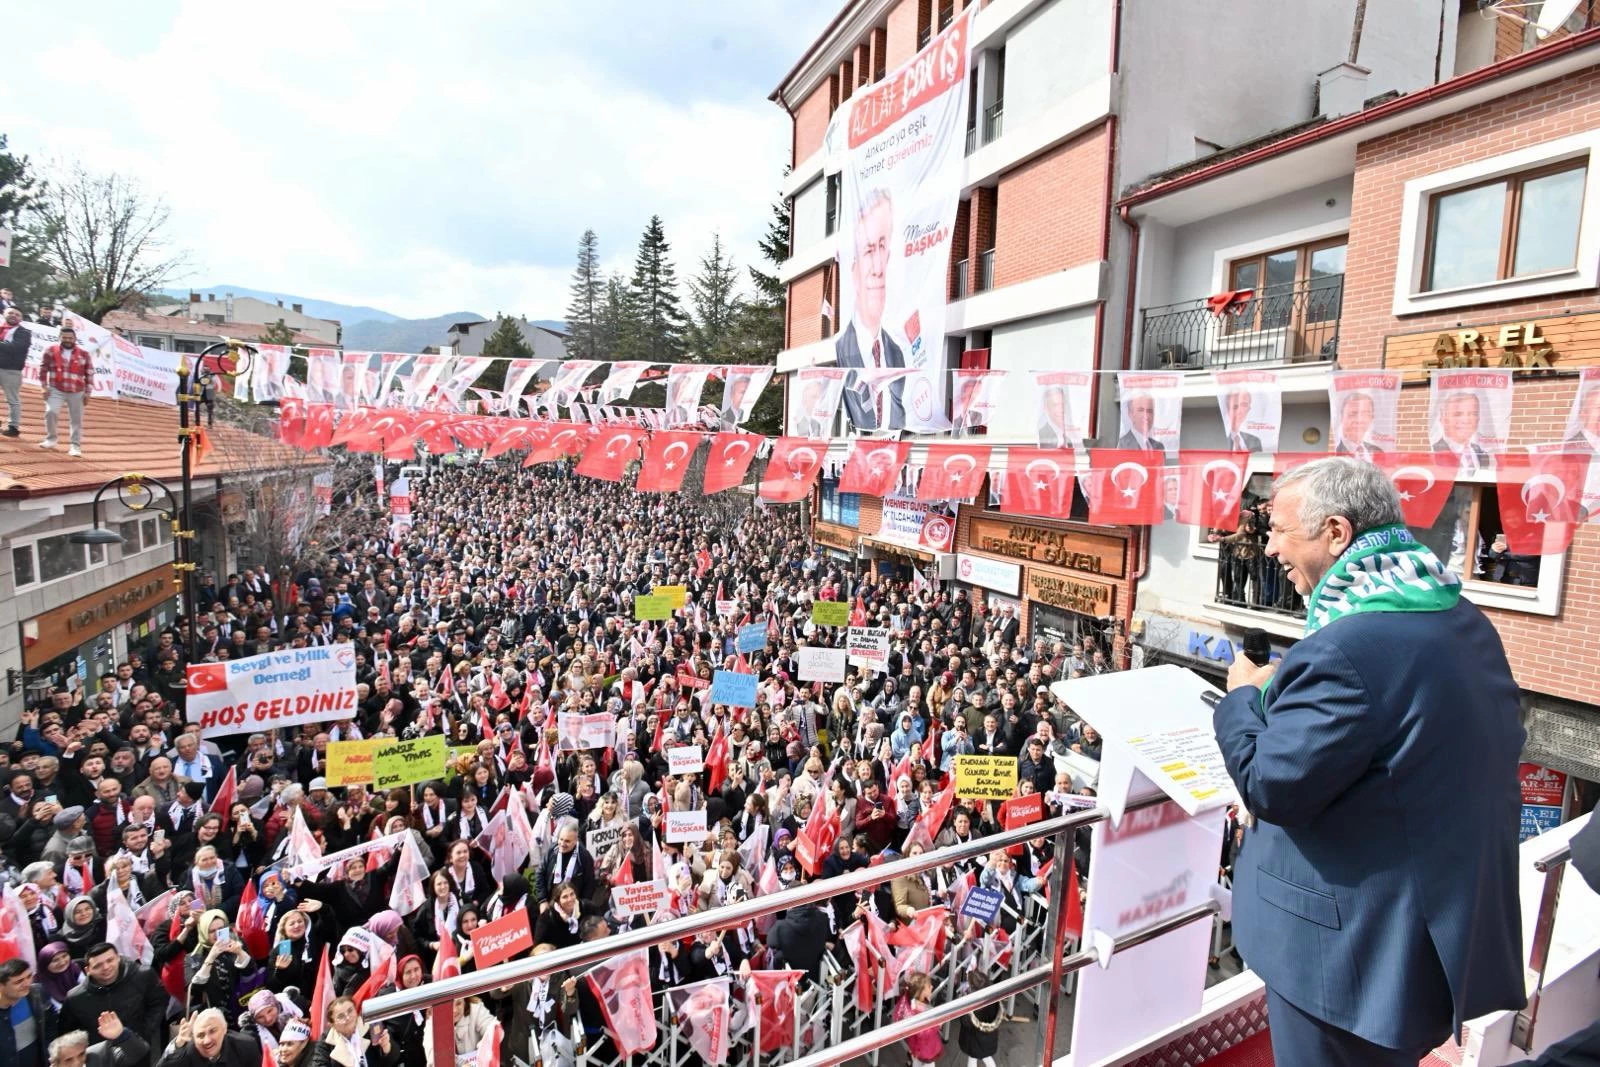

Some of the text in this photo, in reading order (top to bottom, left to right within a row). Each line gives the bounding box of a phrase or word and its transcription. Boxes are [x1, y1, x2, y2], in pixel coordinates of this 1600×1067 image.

[852, 99, 870, 137] AZ
[901, 47, 938, 112] ÇOK
[908, 114, 927, 136] eşit
[904, 227, 949, 258] BAŞKAN
[885, 498, 909, 511] MEHMET
[1009, 525, 1068, 548] AVUKAT
[982, 536, 1101, 572] MEHMET GÜVEN
[230, 655, 271, 675] Sevgi
[274, 653, 290, 665] ve
[200, 686, 356, 729] HOŞ GELDİNİZ
[377, 743, 416, 758] MANSUR
[673, 758, 701, 767] BAŞKAN
[1012, 807, 1040, 818] BAŞKAN
[1521, 808, 1559, 819] R-EL
[671, 825, 705, 834] BAŞKAN
[619, 892, 664, 905] Gardaşım
[625, 884, 654, 896] Yavaş
[628, 901, 658, 912] Yavaş
[477, 928, 515, 948] Mansur
[481, 927, 528, 956] BAŞKAN
